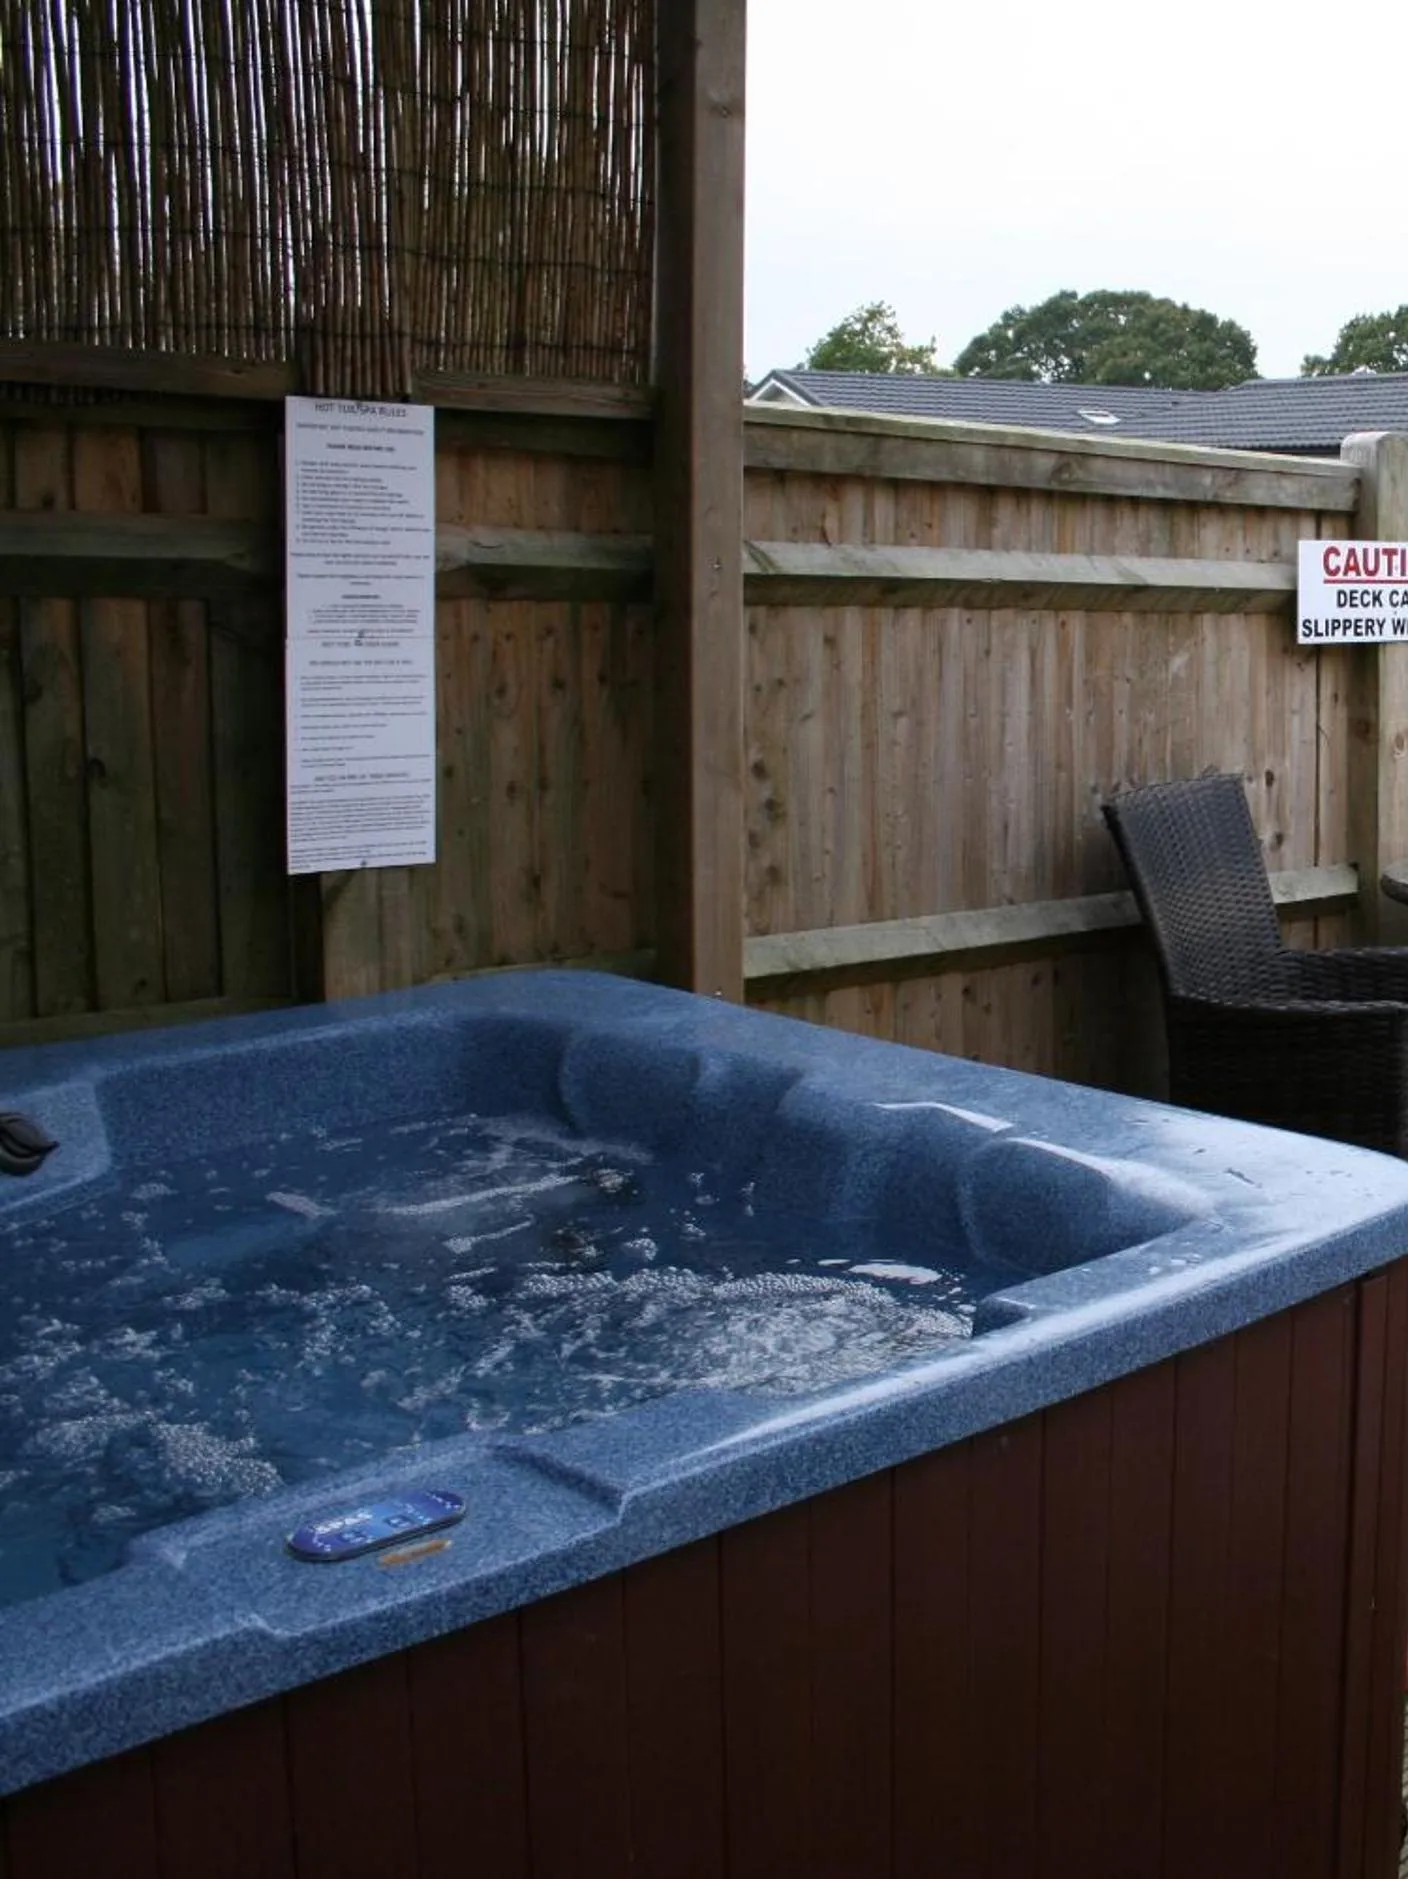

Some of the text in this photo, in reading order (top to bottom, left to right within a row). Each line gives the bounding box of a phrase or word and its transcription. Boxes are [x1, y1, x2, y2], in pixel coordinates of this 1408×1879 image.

[315, 403, 333, 413] HOT
[1336, 589, 1383, 609] DECK
[1302, 617, 1386, 638] SLIPPERY
